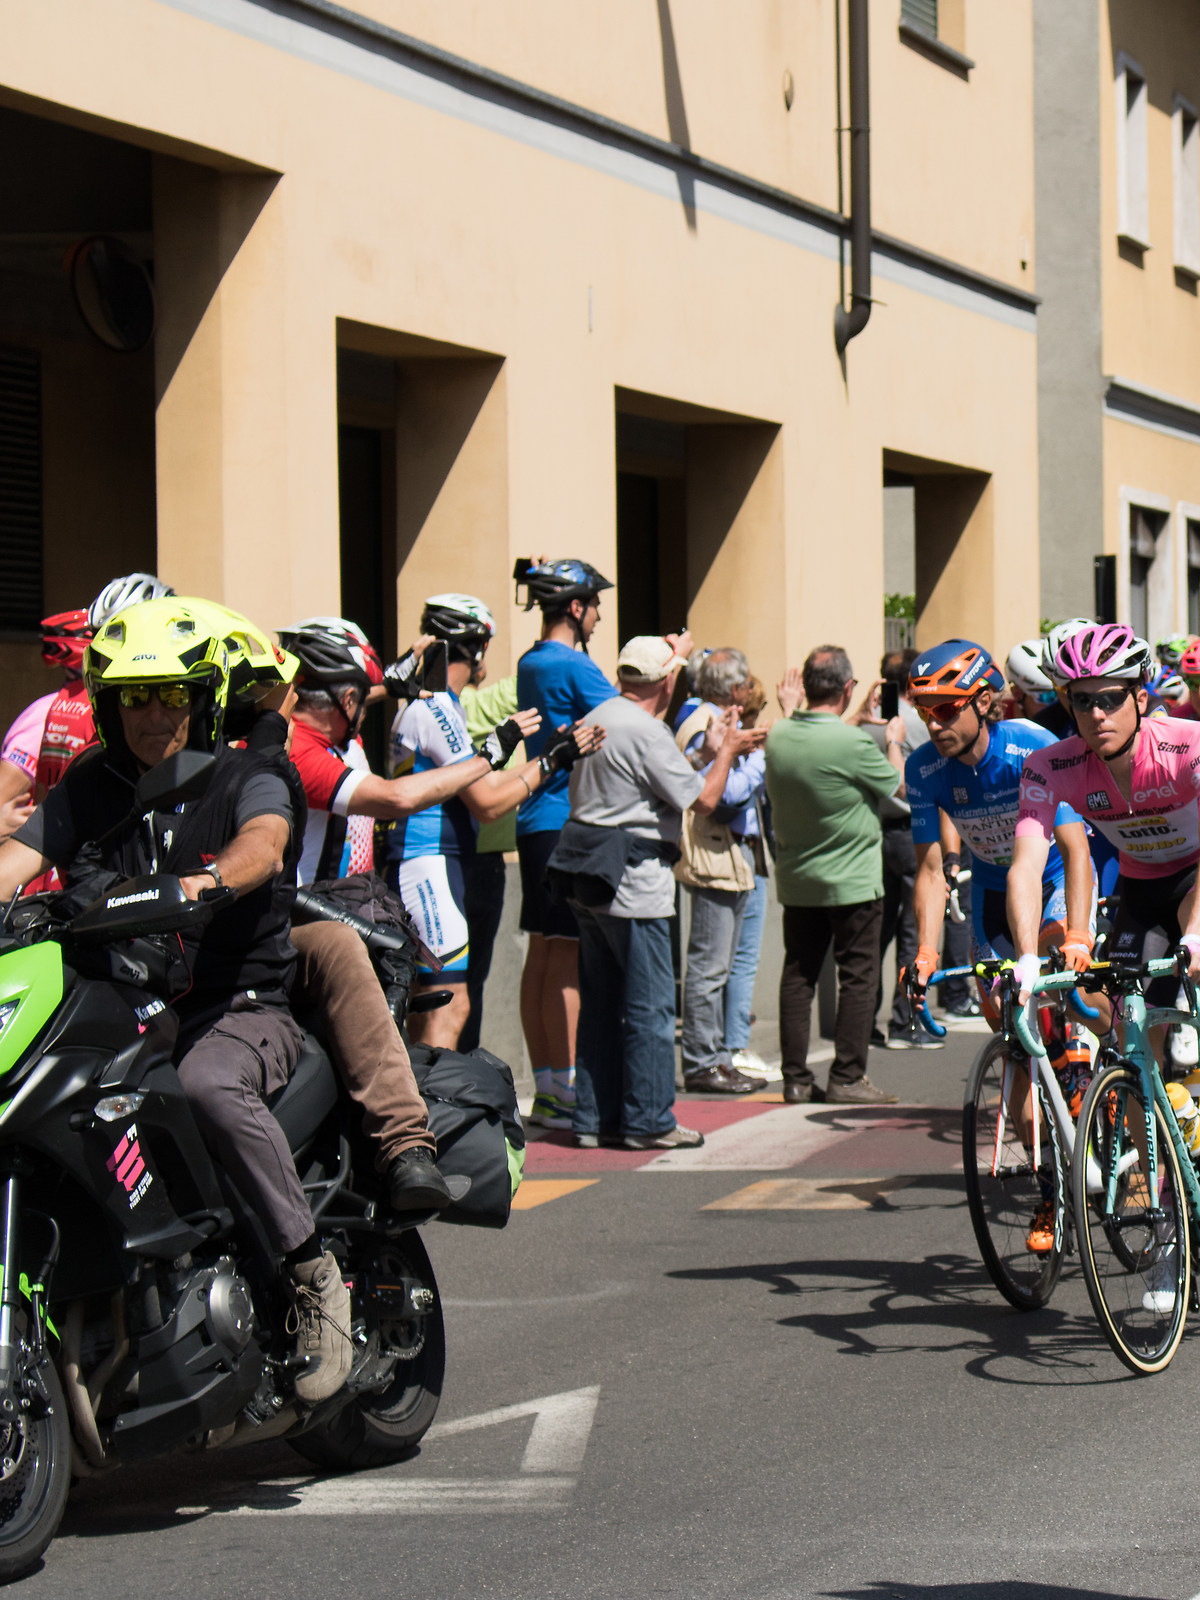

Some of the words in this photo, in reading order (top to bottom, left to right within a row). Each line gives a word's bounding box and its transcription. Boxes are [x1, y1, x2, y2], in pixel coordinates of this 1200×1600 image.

[1134, 781, 1178, 803] enel
[1154, 803, 1175, 815] Sport
[1126, 837, 1187, 852] JUMBO
[106, 889, 160, 909] Kawasaki
[1143, 1096, 1157, 1173] Bianchi
